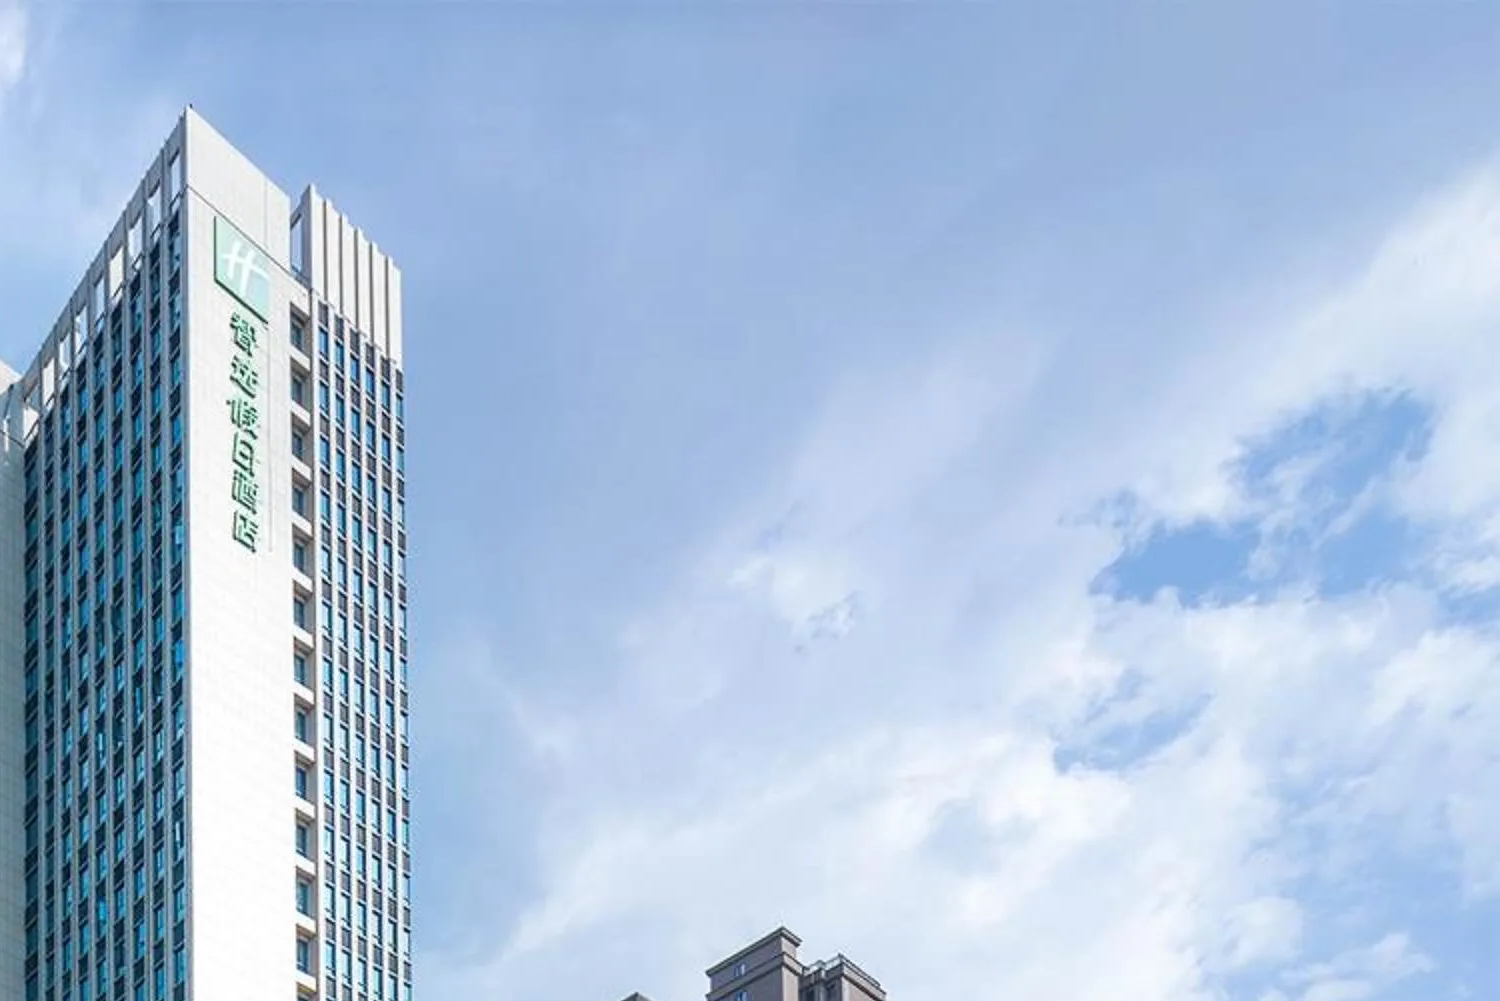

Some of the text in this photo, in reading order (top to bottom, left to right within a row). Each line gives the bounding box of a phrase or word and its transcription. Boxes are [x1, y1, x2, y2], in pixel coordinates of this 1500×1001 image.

[226, 311, 259, 553] 智选假日酒店
